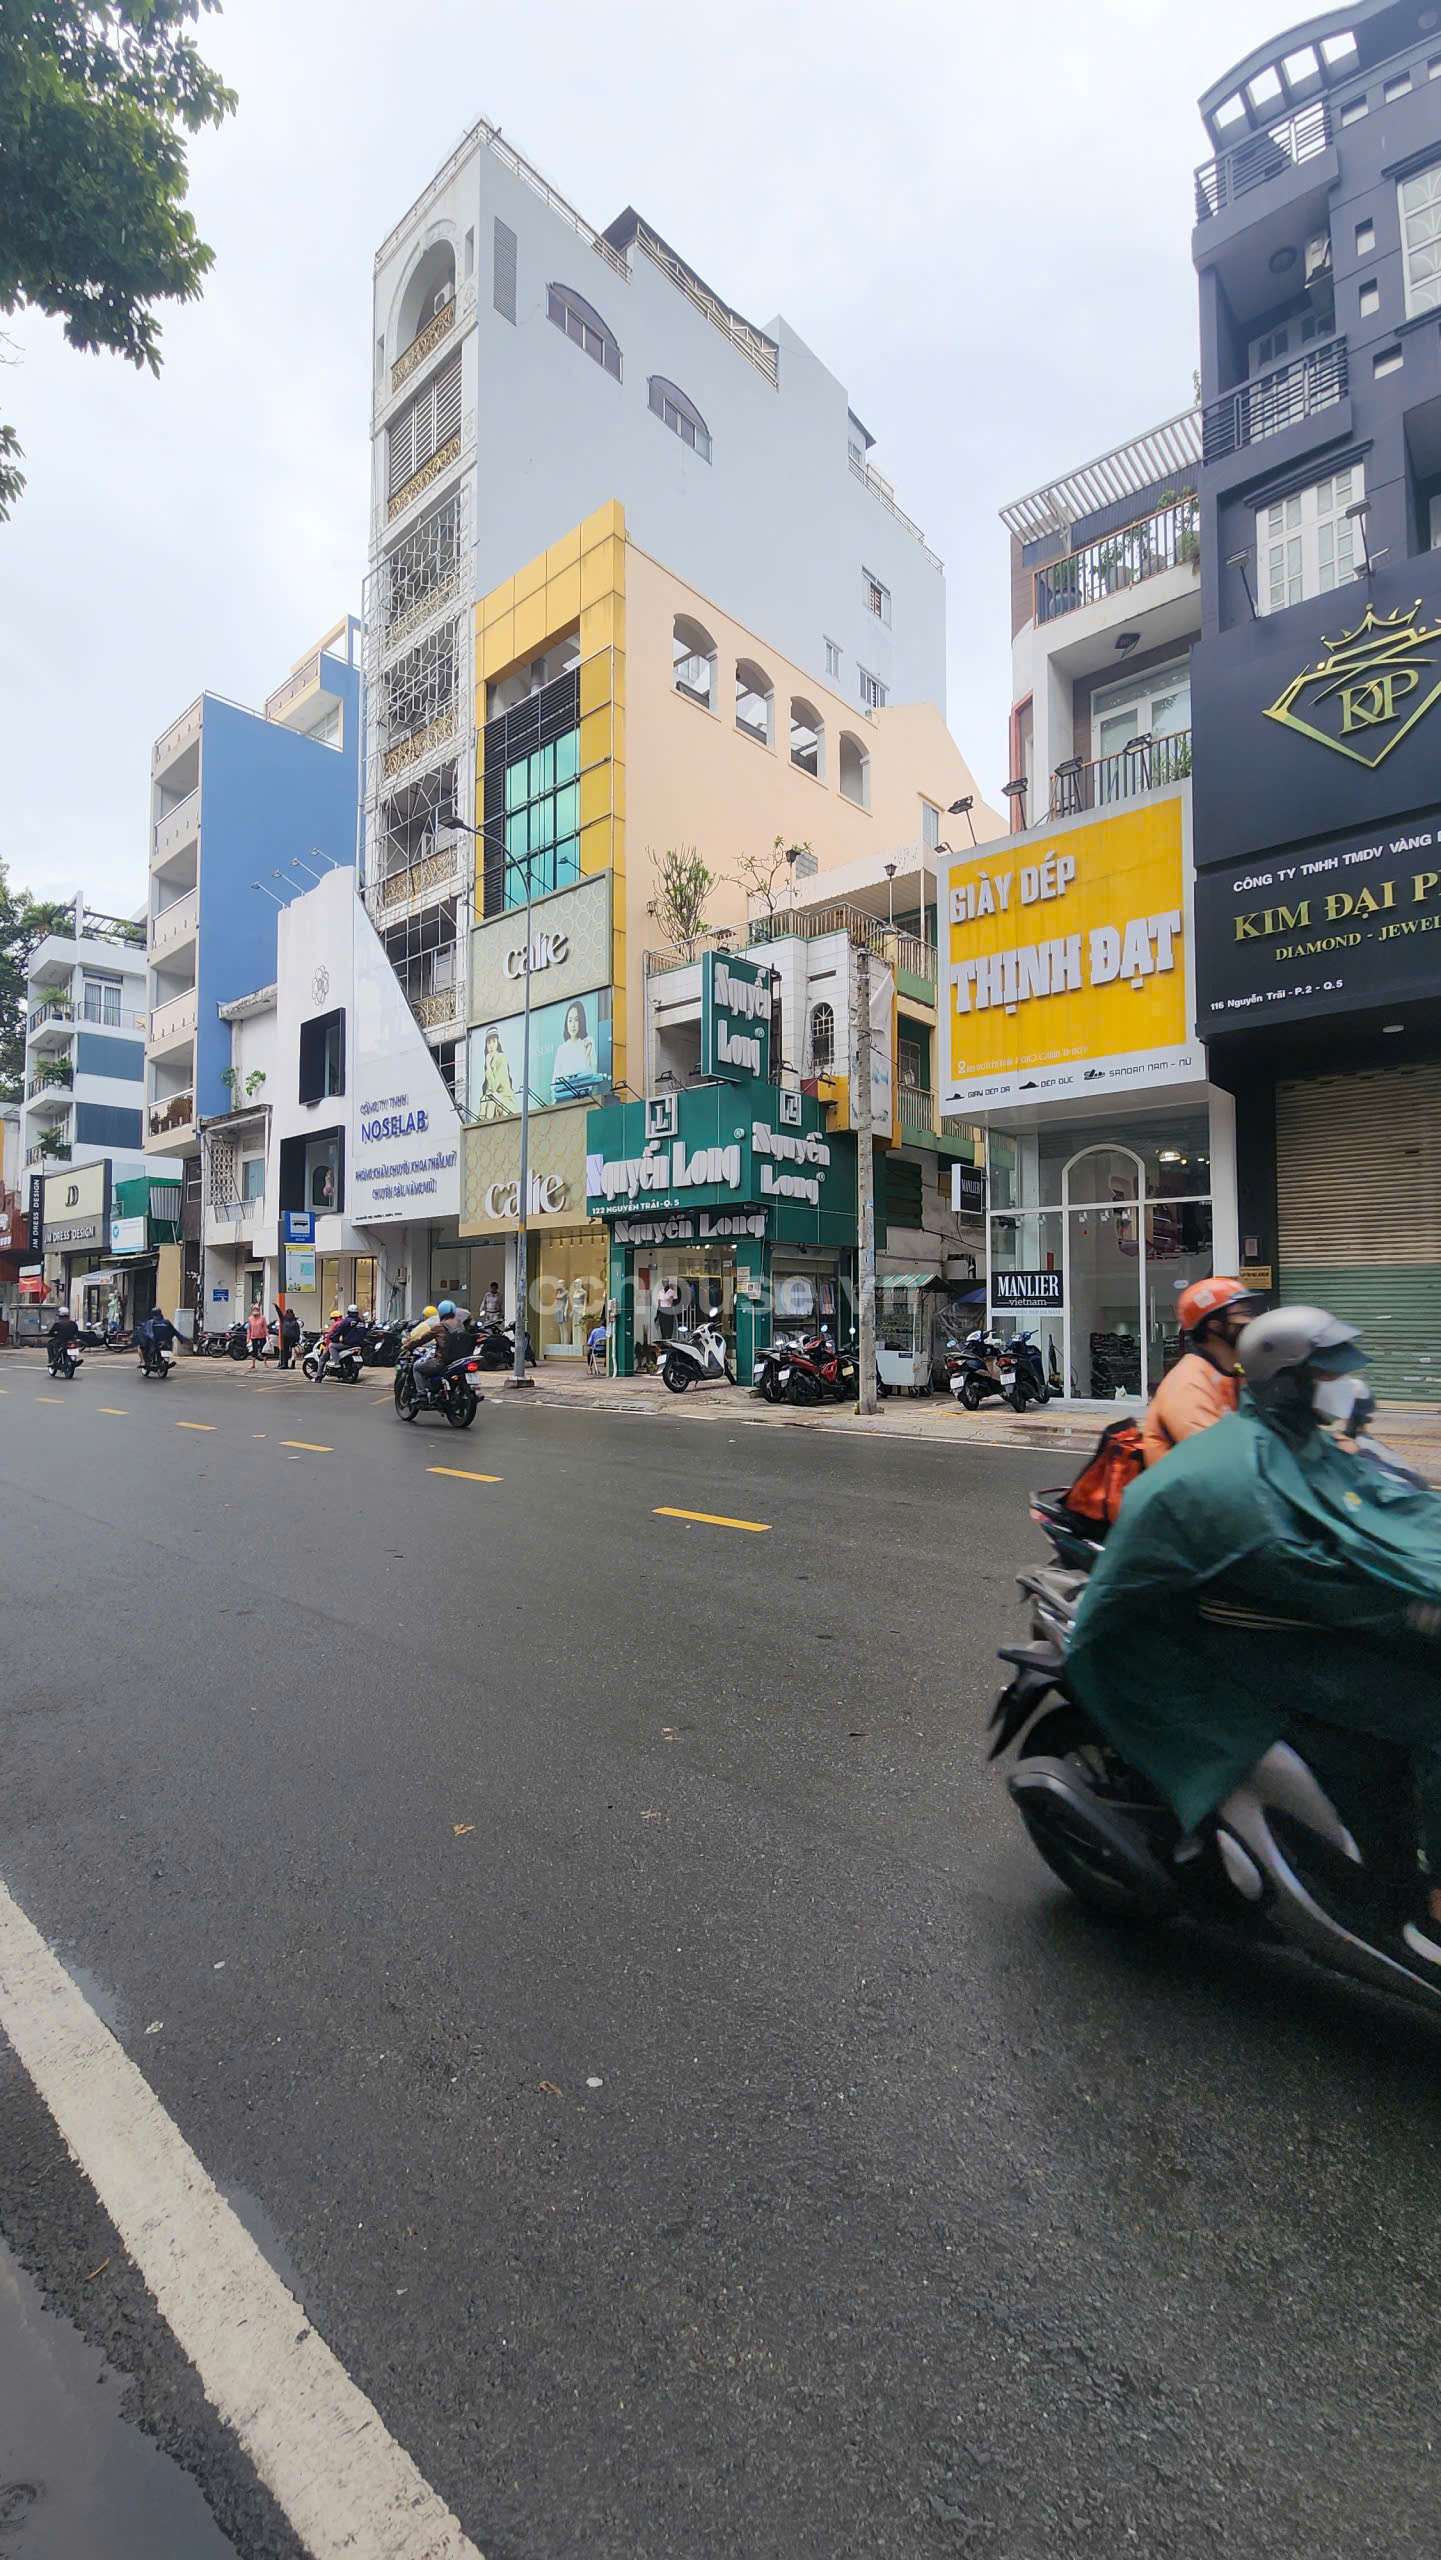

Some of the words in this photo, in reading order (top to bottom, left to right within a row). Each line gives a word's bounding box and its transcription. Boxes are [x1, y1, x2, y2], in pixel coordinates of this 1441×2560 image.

[1233, 873, 1273, 893] CÔNG
[1277, 867, 1297, 883] TY
[1300, 857, 1339, 876] TNHH
[1342, 846, 1384, 866] TMDV
[1389, 834, 1432, 854] VÀNG
[950, 871, 1013, 924] GIÀY
[1020, 850, 1077, 905] DÉP
[1233, 900, 1313, 942] KIM
[1324, 880, 1398, 919] ĐẠI
[1410, 869, 1441, 902] P
[1275, 932, 1361, 961] DIAMOND
[951, 933, 1083, 1016] THỊNH
[1089, 910, 1182, 989] ĐẠT
[1227, 993, 1264, 1009] Nguyễn
[717, 1019, 760, 1077] Long
[361, 1110, 428, 1143] NOSELAB
[673, 1141, 741, 1189] Long
[32, 1179, 40, 1208] DESIGN
[760, 1164, 819, 1205] Long
[32, 1210, 40, 1236] DRESS
[52, 1230, 71, 1243] DRESS
[71, 1225, 96, 1240] DESIGN
[699, 1213, 766, 1239] Long
[32, 1237, 40, 1249] JM
[997, 1275, 1060, 1297] MANLIER
[1008, 1298, 1048, 1306] vietnam
